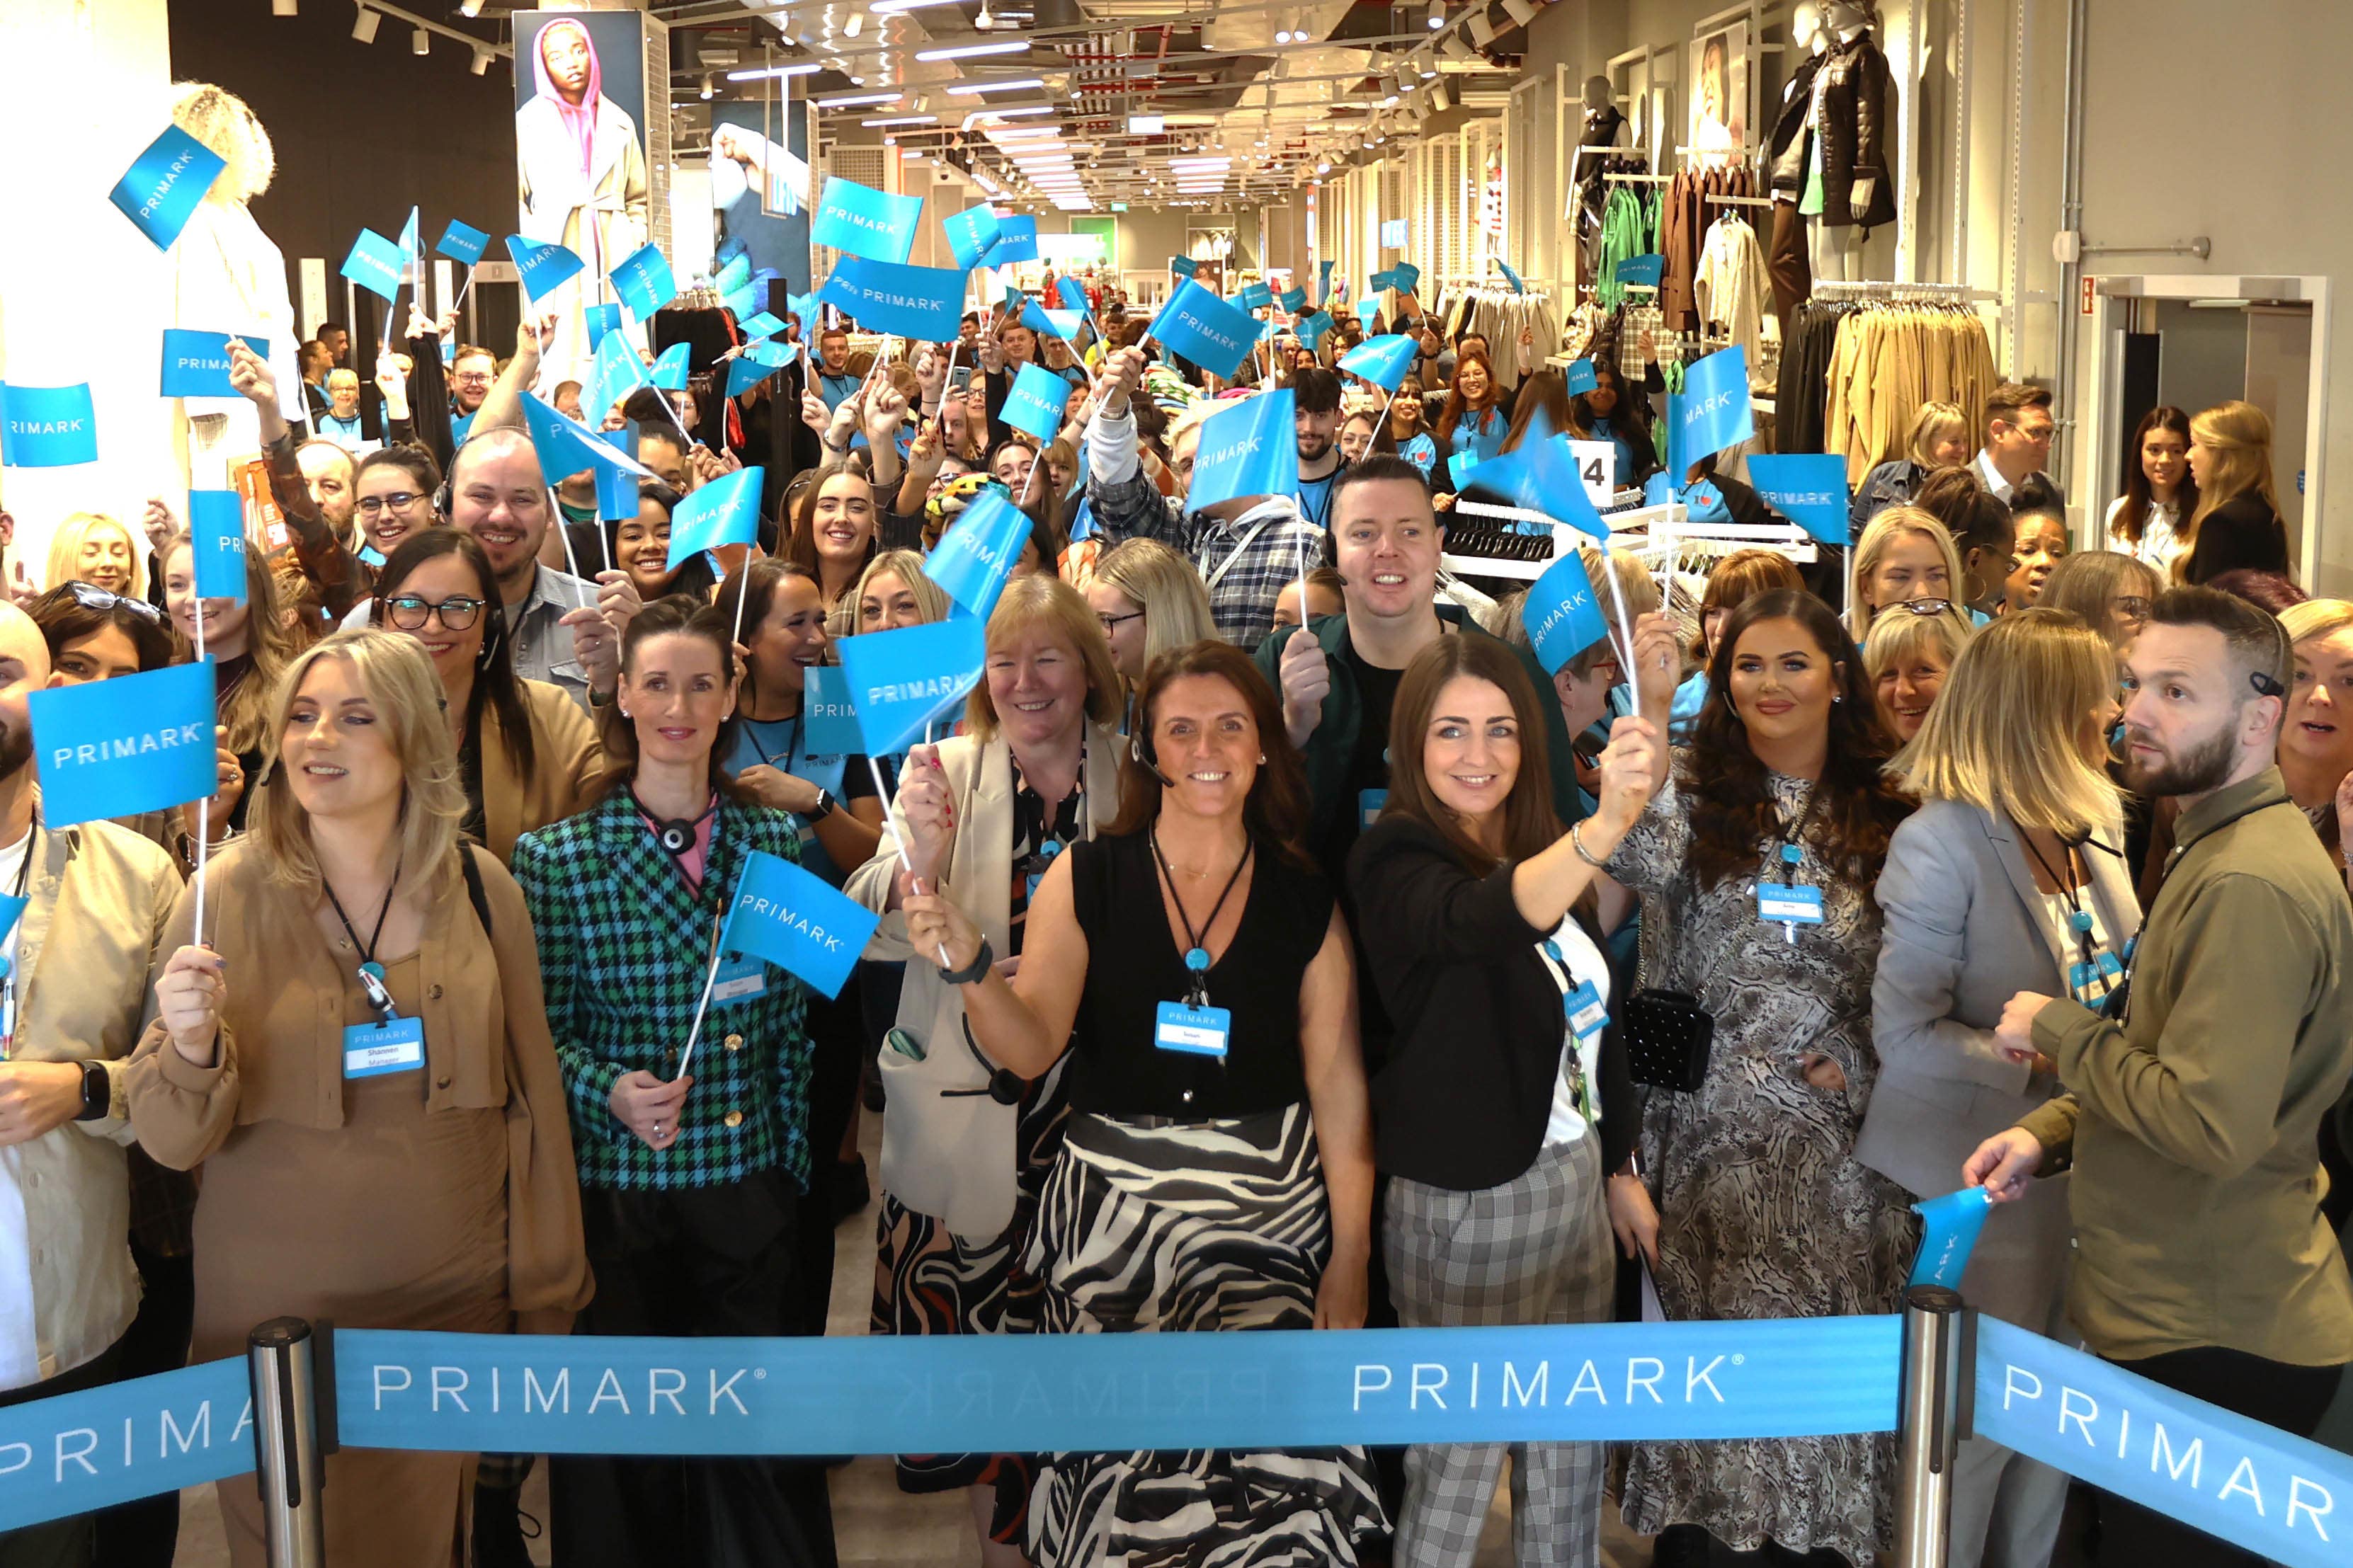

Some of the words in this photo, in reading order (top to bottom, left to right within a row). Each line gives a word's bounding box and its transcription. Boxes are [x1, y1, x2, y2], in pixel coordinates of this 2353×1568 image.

[140, 150, 193, 219] PRIMARK
[826, 206, 896, 234] PRIMARK
[634, 263, 660, 305] PRIMARK
[863, 289, 944, 311] PRIMARK
[1177, 311, 1238, 350] PRIMARK
[1195, 438, 1263, 473] PRIMARK
[675, 499, 744, 539] PRIMARK
[1534, 590, 1587, 650] PRIMARK
[54, 723, 203, 769] PRIMARK
[1768, 891, 1811, 900] PRIMARK
[739, 895, 845, 952] PRIMARK
[355, 1030, 409, 1044] PRIMARK
[1169, 1012, 1219, 1026] PRIMARK
[2003, 1363, 2334, 1543] PRIMAR
